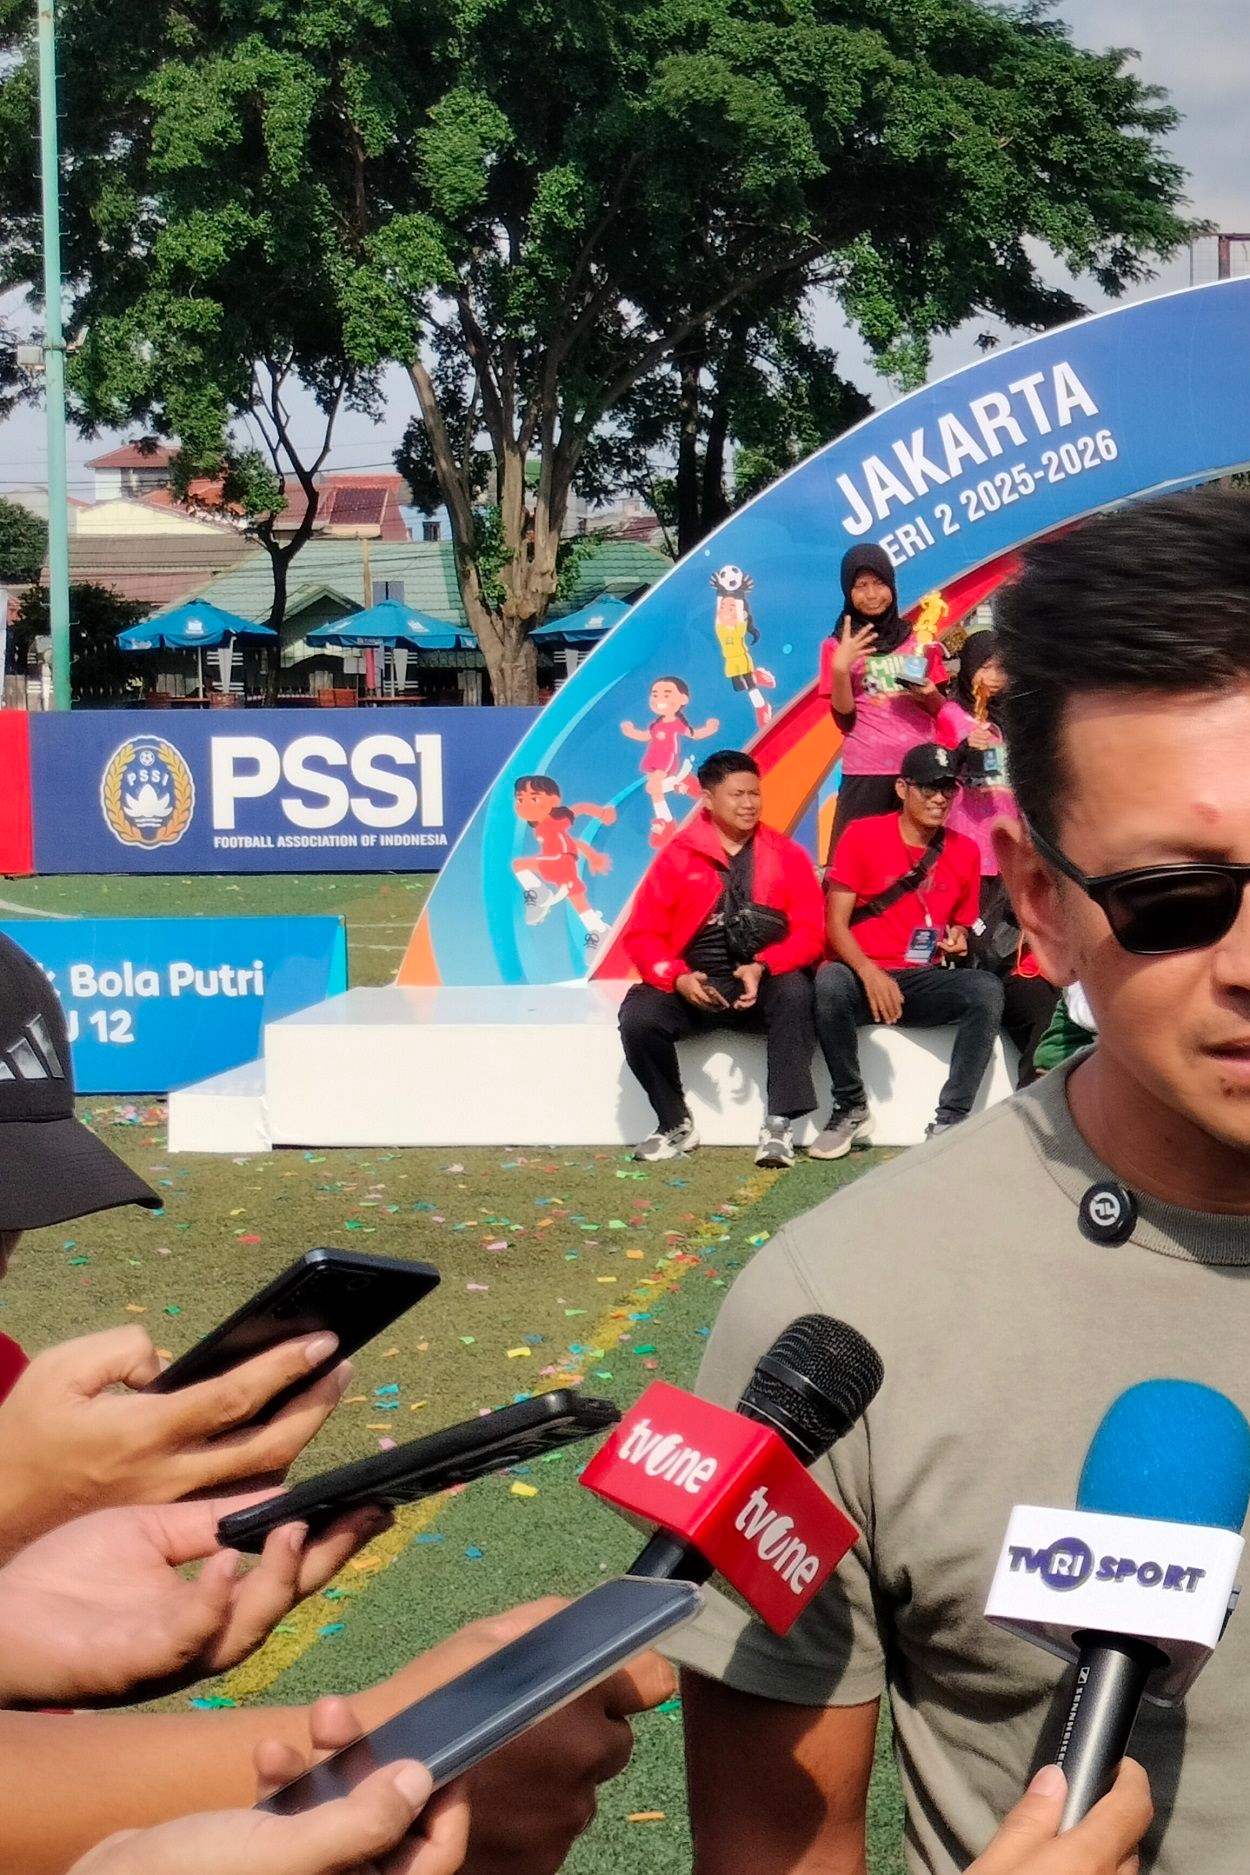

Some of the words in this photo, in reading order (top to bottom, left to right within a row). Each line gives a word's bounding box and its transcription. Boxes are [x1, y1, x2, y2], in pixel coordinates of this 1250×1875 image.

[836, 361, 1099, 537] JAKARTA
[878, 516, 936, 567] ERI
[934, 503, 960, 536] 2
[959, 429, 1118, 523] 2025-2026
[127, 769, 169, 787] PSSI
[211, 734, 444, 829] PSSI
[214, 835, 274, 848] FOOTBALL
[277, 835, 357, 848] ASSOCIATION
[361, 834, 377, 847] OF
[380, 833, 448, 846] INDONESIA
[70, 961, 159, 998] Bola
[169, 960, 264, 997] Putri
[89, 1009, 135, 1043] 12
[618, 1418, 718, 1493] tvOne
[734, 1485, 819, 1595] tvOne
[1008, 1543, 1087, 1580] TVRI
[1096, 1555, 1207, 1593] SPORT
